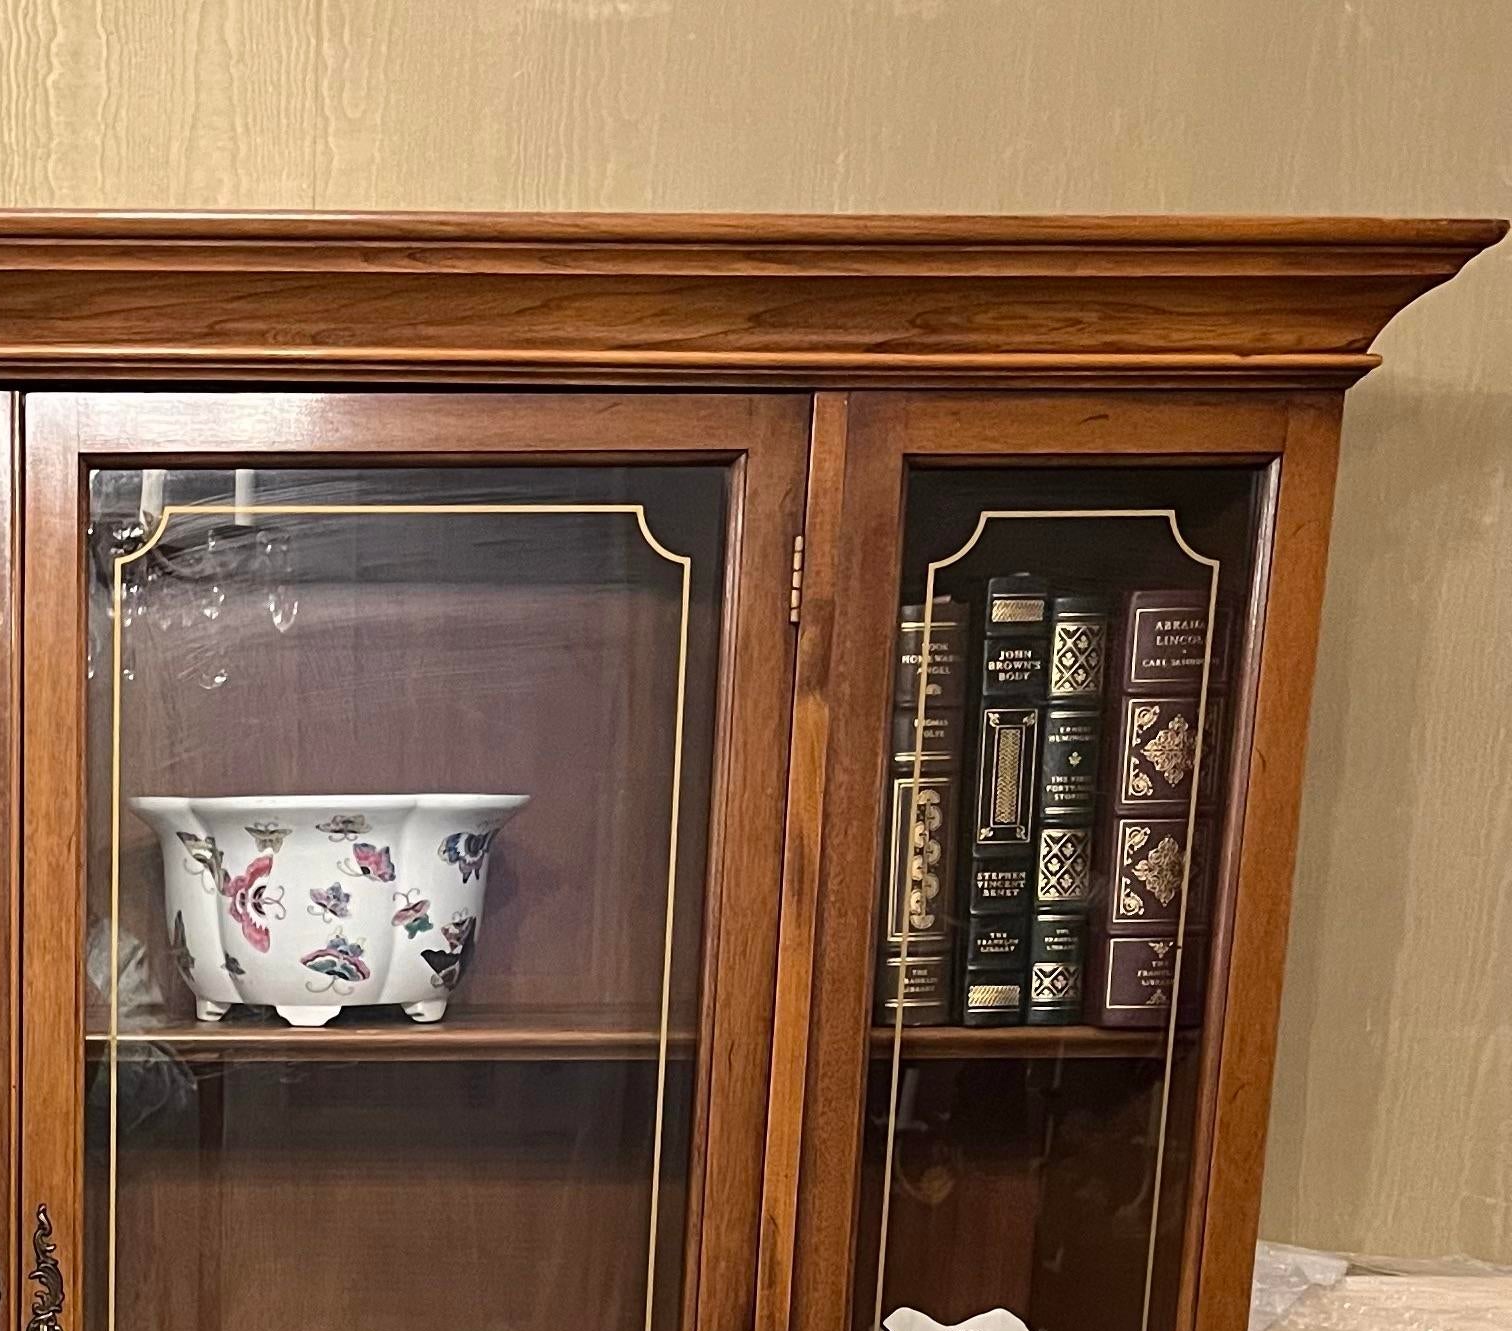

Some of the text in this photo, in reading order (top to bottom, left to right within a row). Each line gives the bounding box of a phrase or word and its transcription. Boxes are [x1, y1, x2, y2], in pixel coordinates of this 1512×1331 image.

[998, 650, 1032, 661] JOHN
[988, 660, 1041, 671] BROWN'S
[998, 672, 1031, 681] BODY
[976, 872, 1026, 880] STEPHEN
[976, 880, 1026, 889] VINCENT
